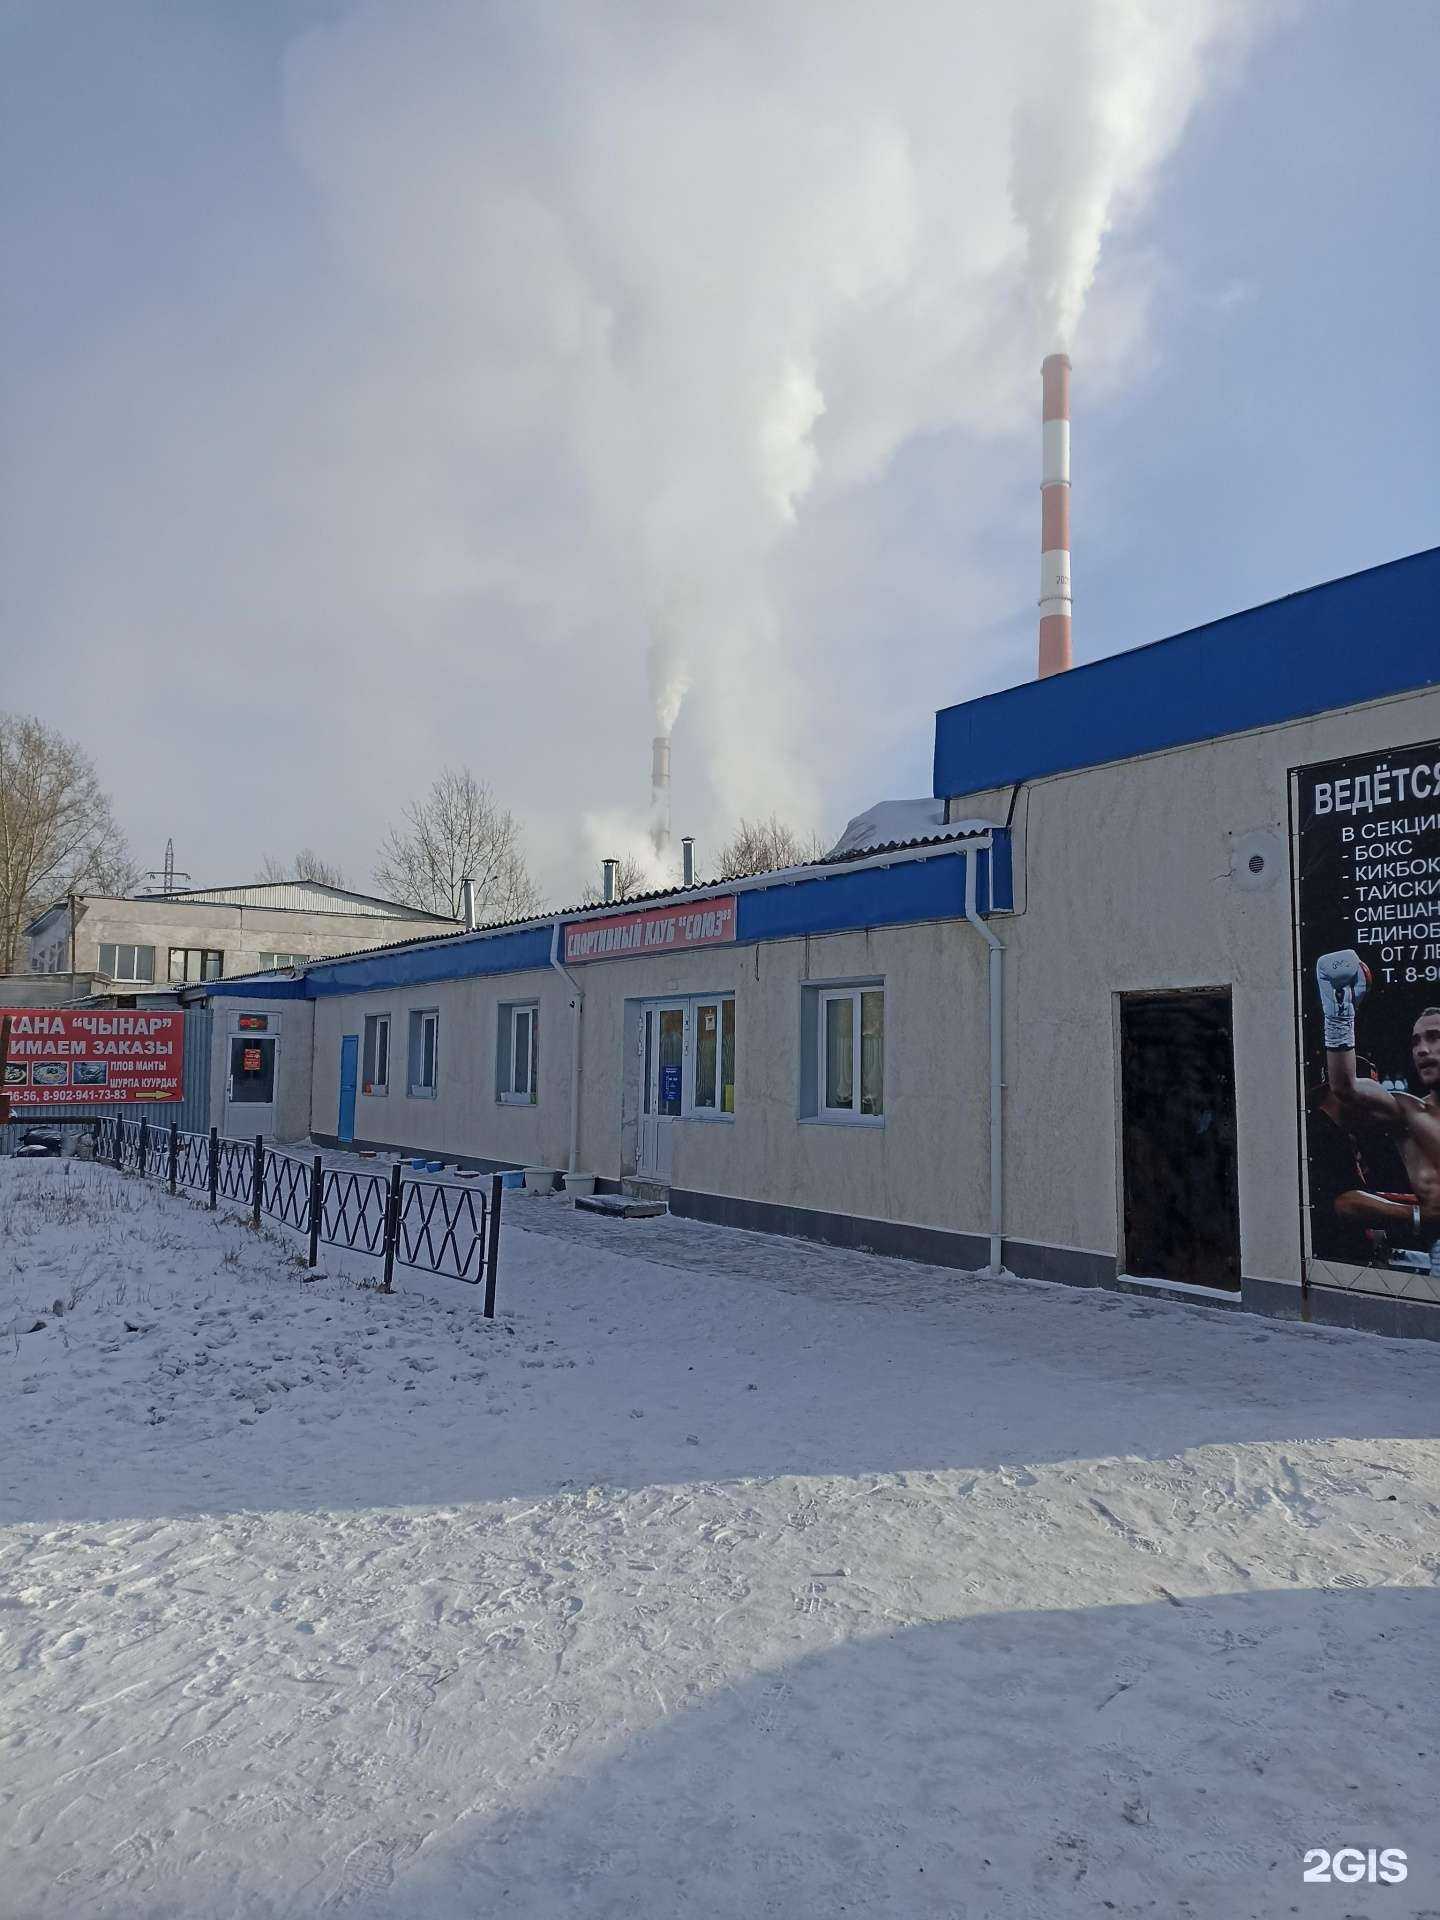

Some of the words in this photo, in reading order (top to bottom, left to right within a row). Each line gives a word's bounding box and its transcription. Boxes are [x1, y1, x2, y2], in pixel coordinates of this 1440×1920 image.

[1342, 827, 1355, 842] В
[1361, 814, 1440, 838] СЕКЦИ
[1355, 839, 1413, 861] БОКС
[1355, 857, 1440, 881] КИКБОК
[1354, 901, 1440, 922] СМЕШАН
[567, 919, 642, 957] СПОРТИВНЫЙ
[645, 918, 675, 945] КЛУБ
[1381, 946, 1404, 962] ОТ
[1410, 945, 1418, 960] 7
[1381, 968, 1398, 983] Т.
[1405, 966, 1440, 982] 8-9
[92, 1041, 173, 1055] ЗАКАЗЫ
[110, 1061, 134, 1071] ПЛОВ
[135, 1061, 166, 1071] МАНТЫ
[110, 1078, 139, 1088] ШУРПА
[141, 1078, 177, 1088] КУУРДАК
[43, 1089, 127, 1101] 8-902-941-73-83
